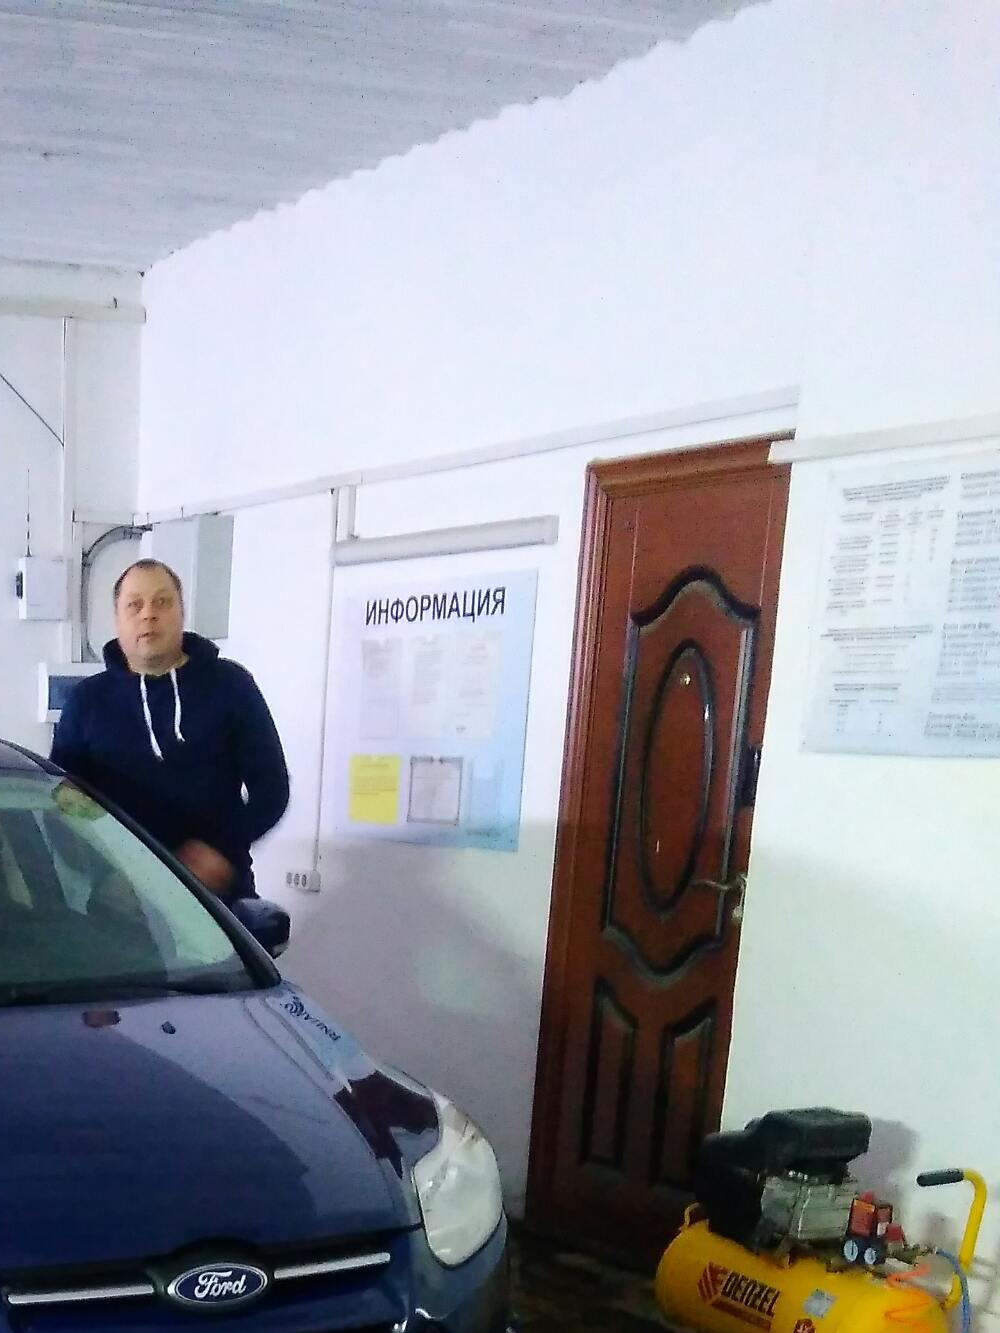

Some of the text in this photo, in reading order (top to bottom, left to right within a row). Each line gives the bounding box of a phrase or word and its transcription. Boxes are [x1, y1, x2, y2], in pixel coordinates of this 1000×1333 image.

[365, 587, 506, 625] ИНФОРМАЦИЯ
[194, 1271, 247, 1299] Ford
[721, 1271, 780, 1317] DENZEL
